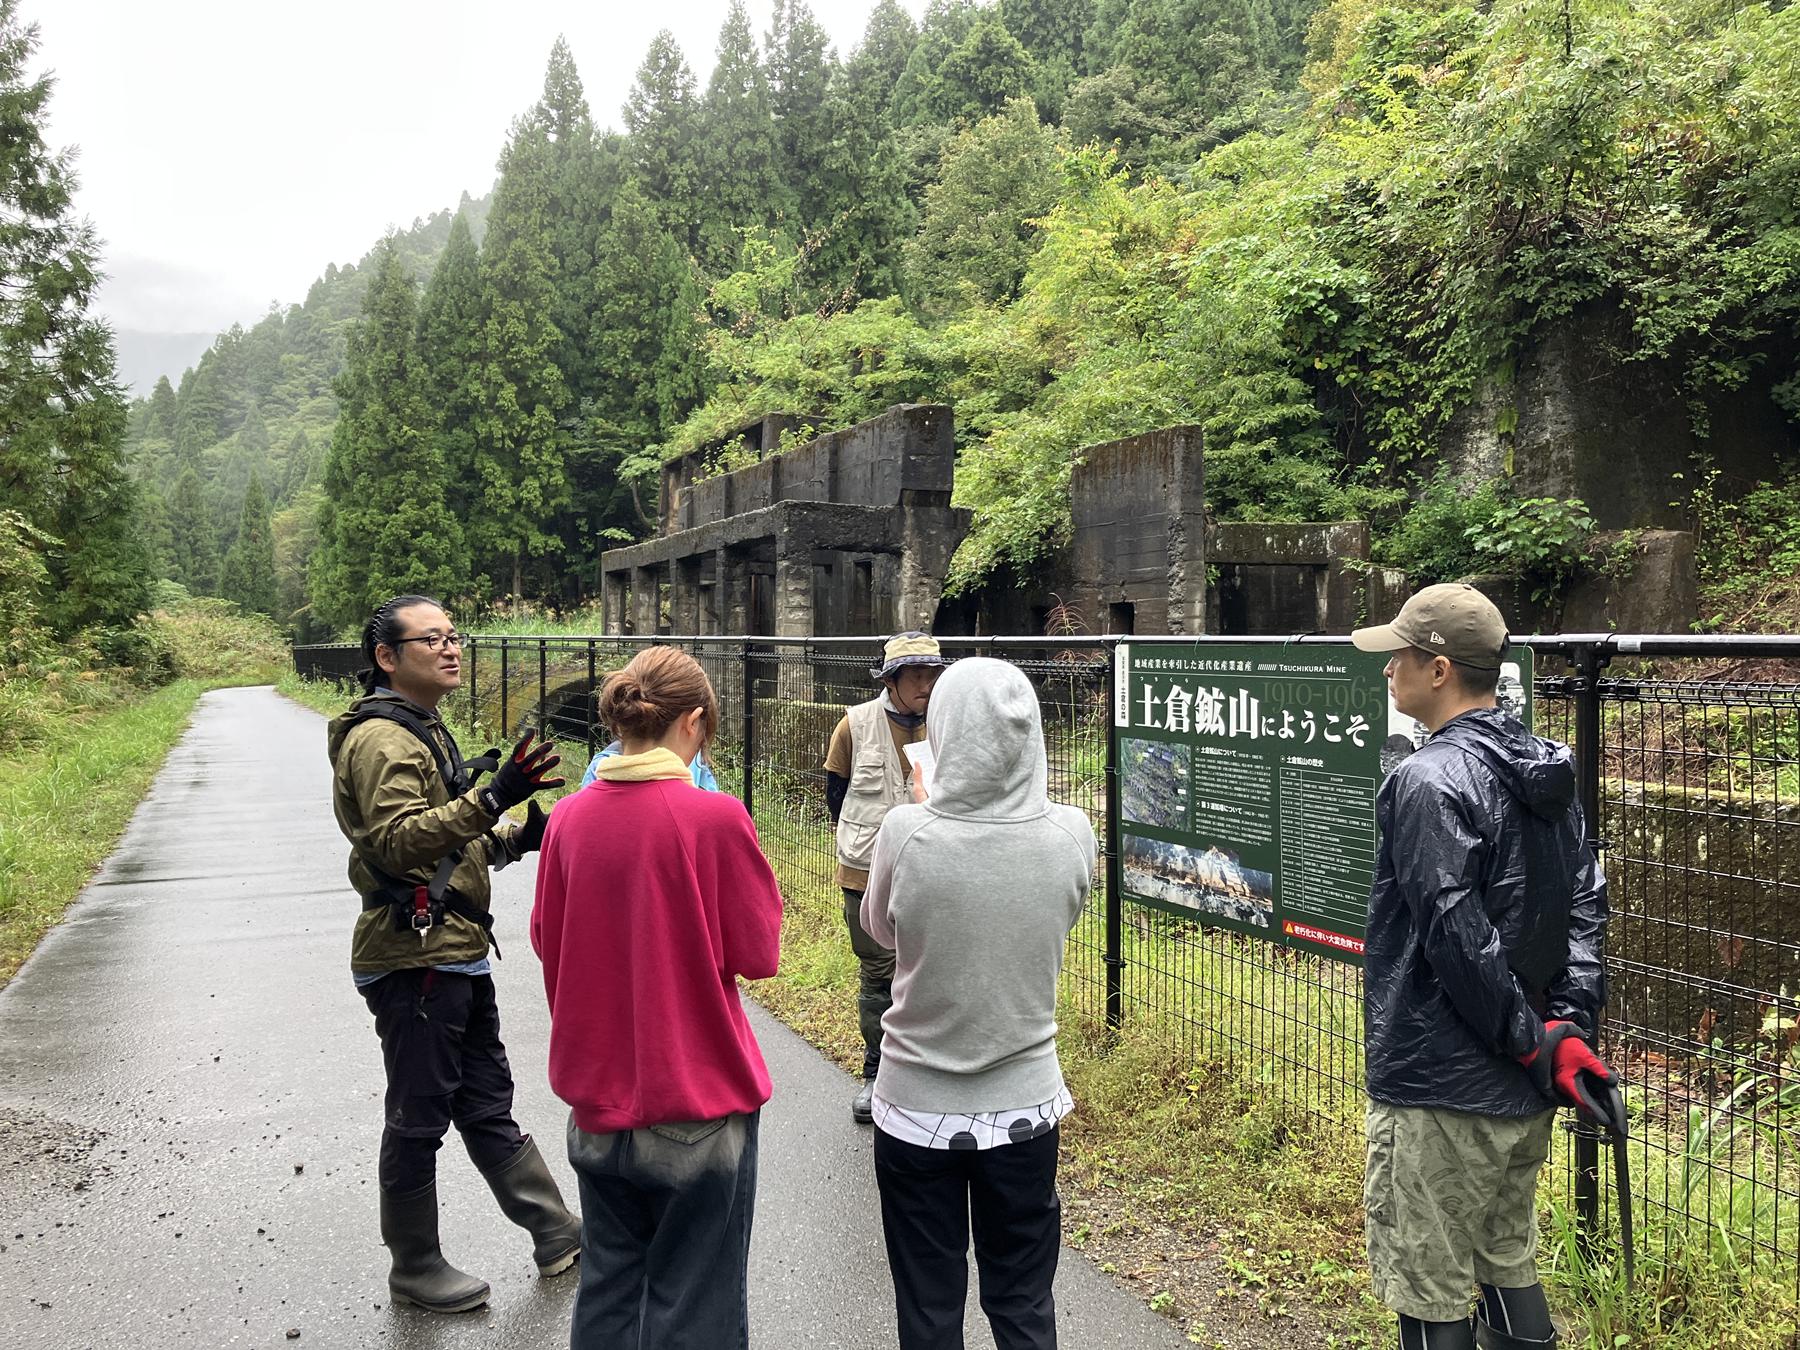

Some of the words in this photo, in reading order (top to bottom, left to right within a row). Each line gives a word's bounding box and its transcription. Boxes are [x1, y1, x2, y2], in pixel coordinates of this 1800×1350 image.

[1279, 664, 1324, 673] TSUCHIKURA
[1326, 665, 1347, 674] MINE
[1134, 683, 1370, 748] 土倉鉱山にようこそ
[1262, 675, 1383, 720] 1910-1965
